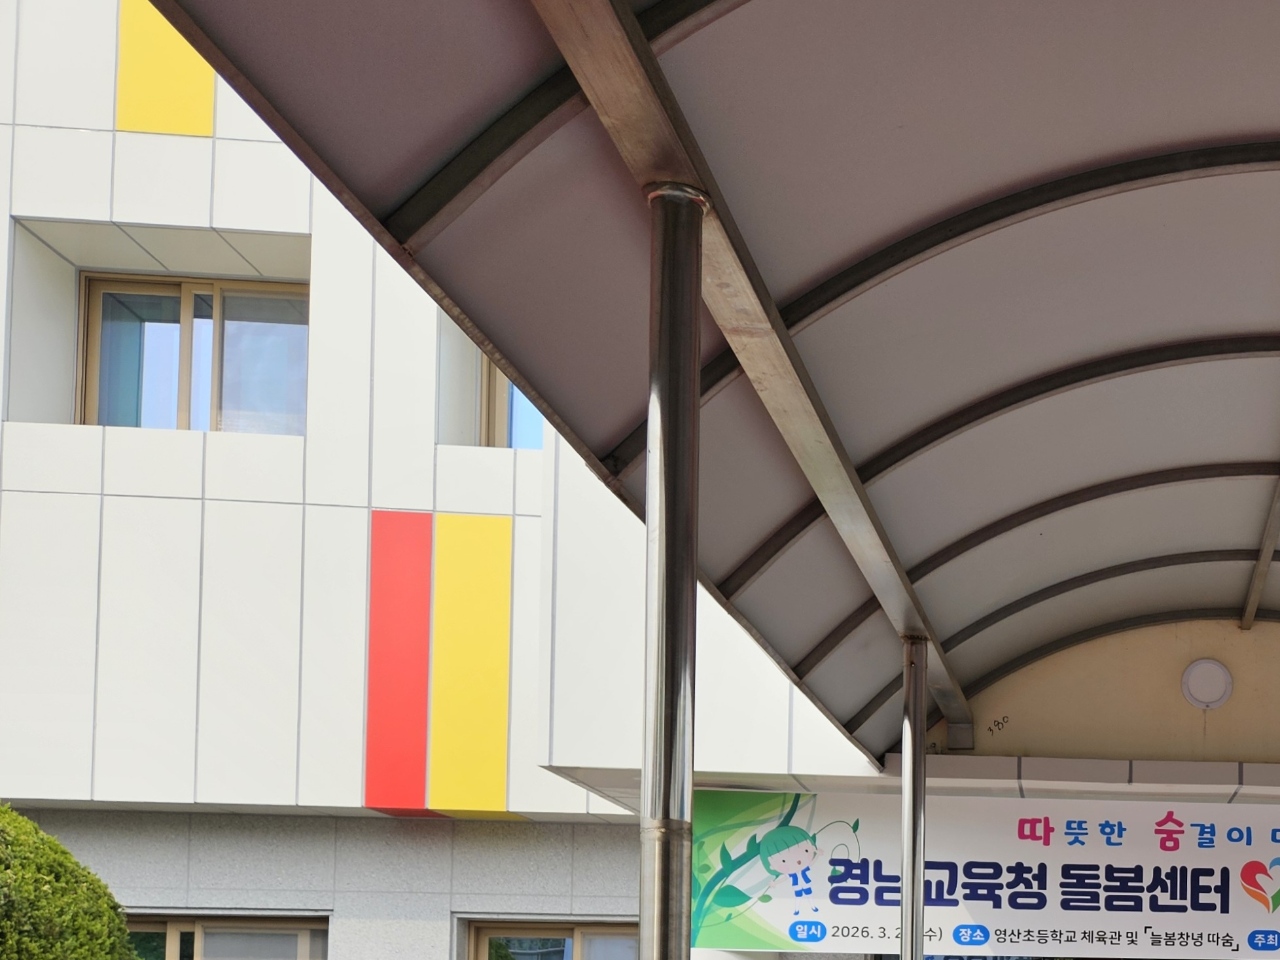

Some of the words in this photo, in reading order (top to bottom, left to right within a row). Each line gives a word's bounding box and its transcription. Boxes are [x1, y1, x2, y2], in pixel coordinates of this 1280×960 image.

[1017, 816, 1127, 846] 따뜻한
[1154, 811, 1253, 851] 숨결이
[1059, 863, 1230, 914] 돌봄센터
[795, 924, 821, 938] 일시
[959, 928, 985, 942] 장소
[994, 928, 1077, 945] 영산초등학교
[1081, 930, 1122, 945] 체육관
[1126, 930, 1138, 946] 및
[1253, 933, 1278, 947] 주최
